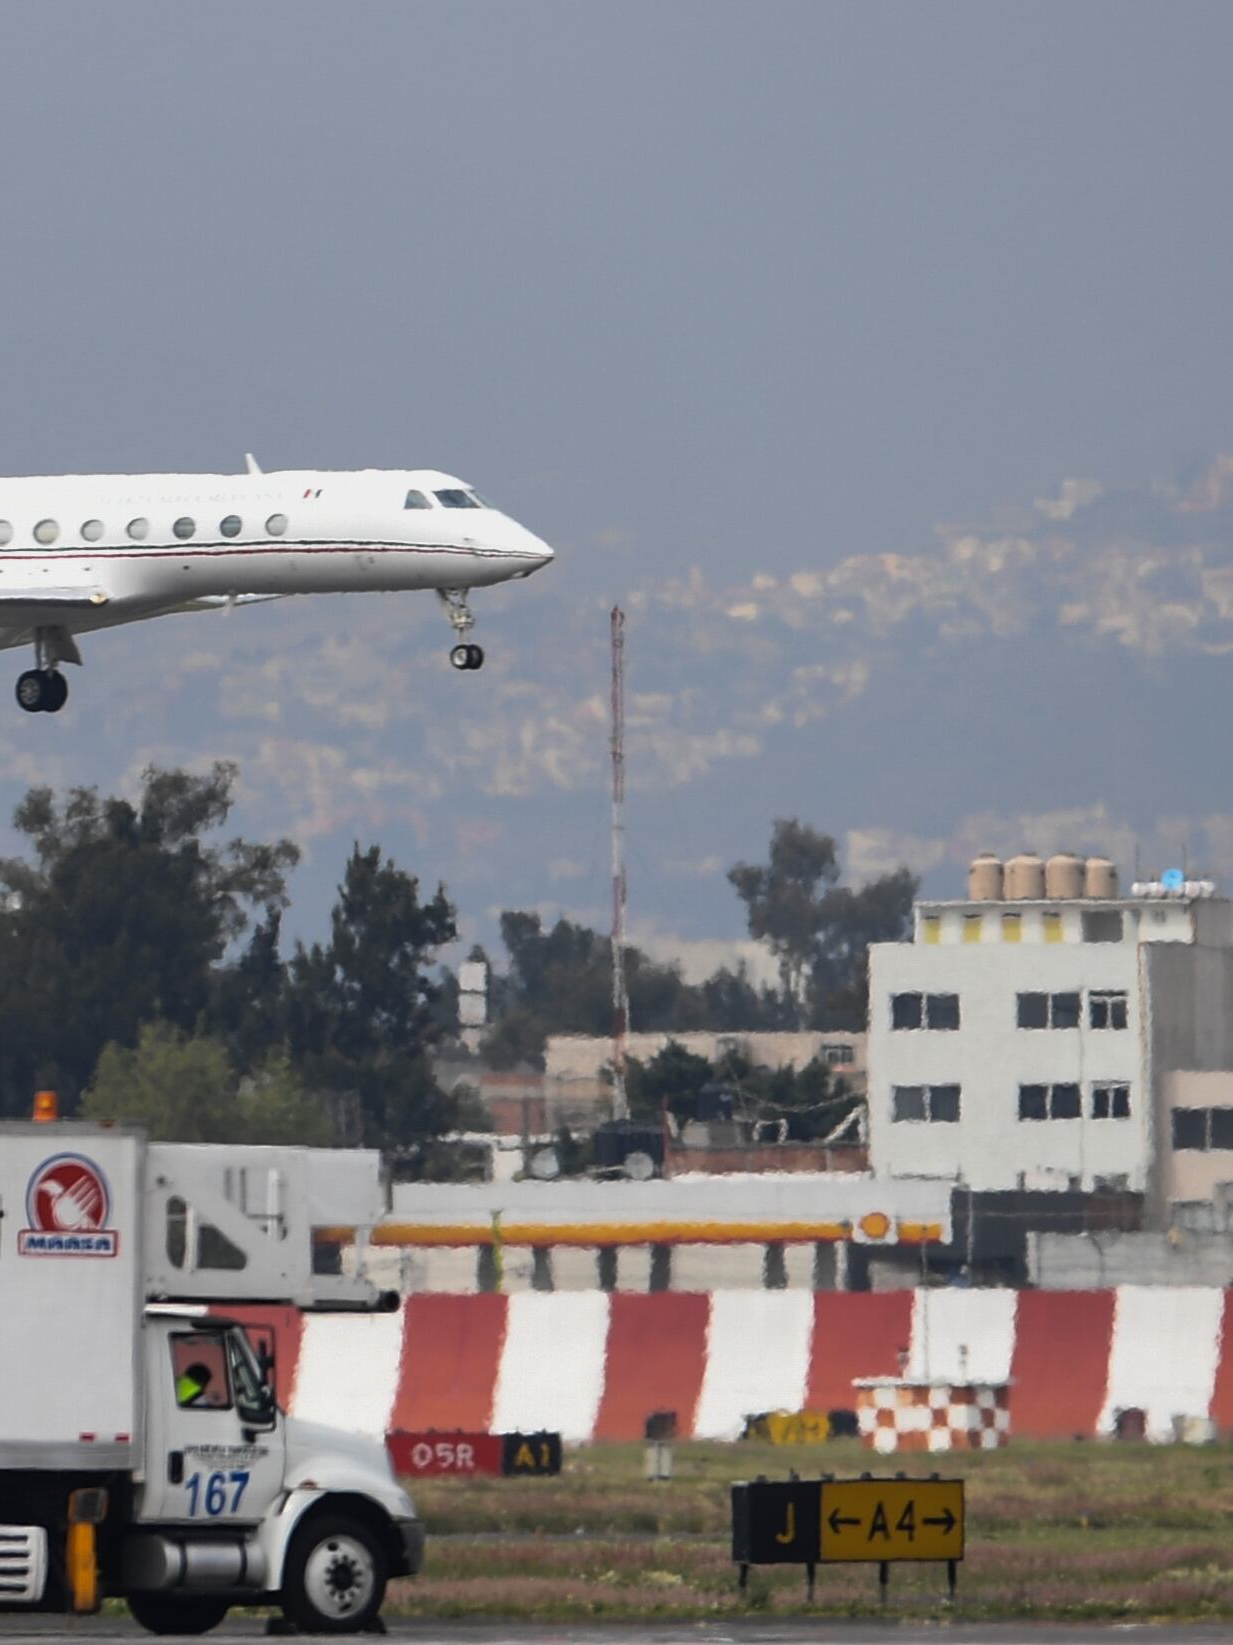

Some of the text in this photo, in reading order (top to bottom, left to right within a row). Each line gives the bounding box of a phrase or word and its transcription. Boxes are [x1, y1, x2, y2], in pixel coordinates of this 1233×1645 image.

[514, 1442, 551, 1468] A1
[185, 1470, 251, 1516] 167
[775, 1502, 795, 1544] J
[867, 1499, 915, 1542] A4
